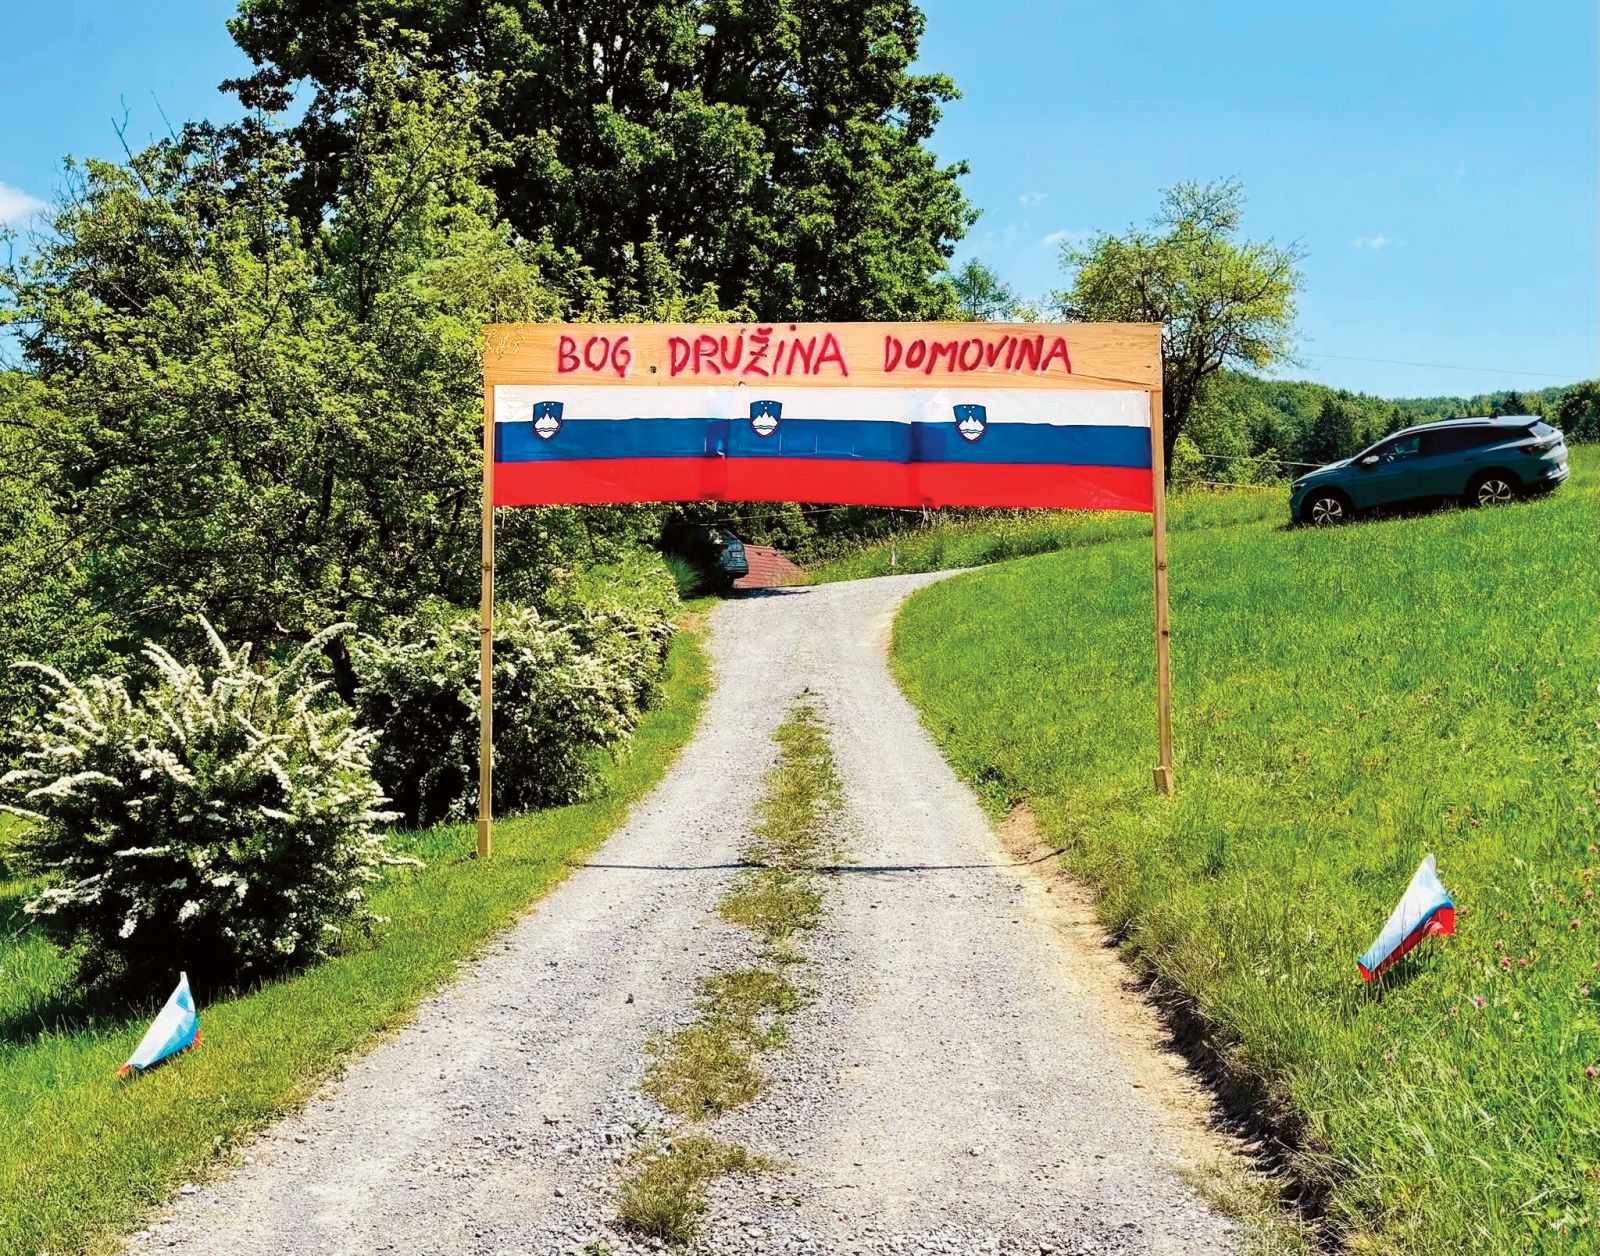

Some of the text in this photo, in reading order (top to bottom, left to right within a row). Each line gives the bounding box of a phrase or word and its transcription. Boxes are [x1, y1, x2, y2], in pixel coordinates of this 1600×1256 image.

[557, 324, 1072, 378] BOG DRUŽINA DOMOVINA
